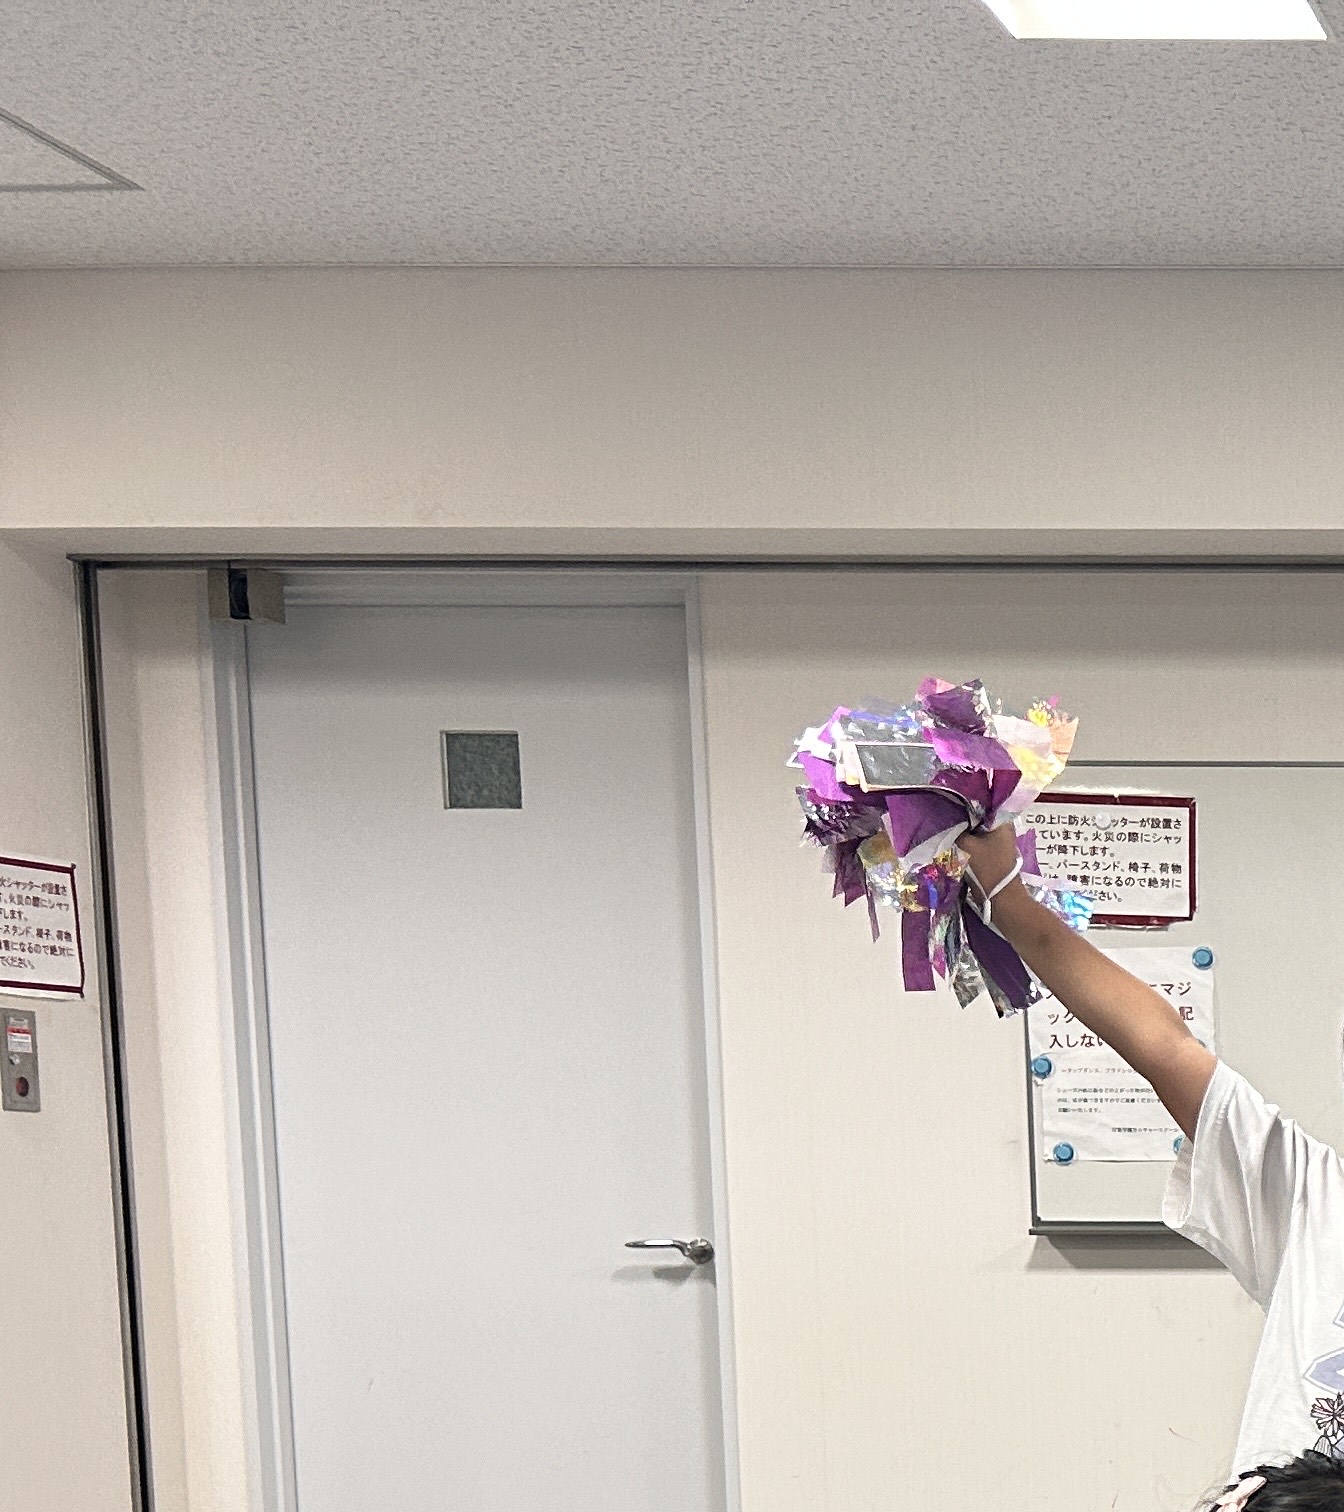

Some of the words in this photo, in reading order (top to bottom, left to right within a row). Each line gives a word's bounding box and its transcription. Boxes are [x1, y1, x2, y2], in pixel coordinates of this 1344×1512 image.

[1025, 814, 1182, 829] この上に防火ッターが設置さ
[1039, 829, 1182, 844] ています。火災の際にシャッ
[1036, 844, 1116, 857] ーが降下します。
[1038, 859, 1182, 874] ー、バースタンド、椅子、荷物
[1043, 873, 1182, 888] 障害になるので絶対に
[0, 939, 75, 956] 害になるので絶対に
[1150, 981, 1192, 996] マジ
